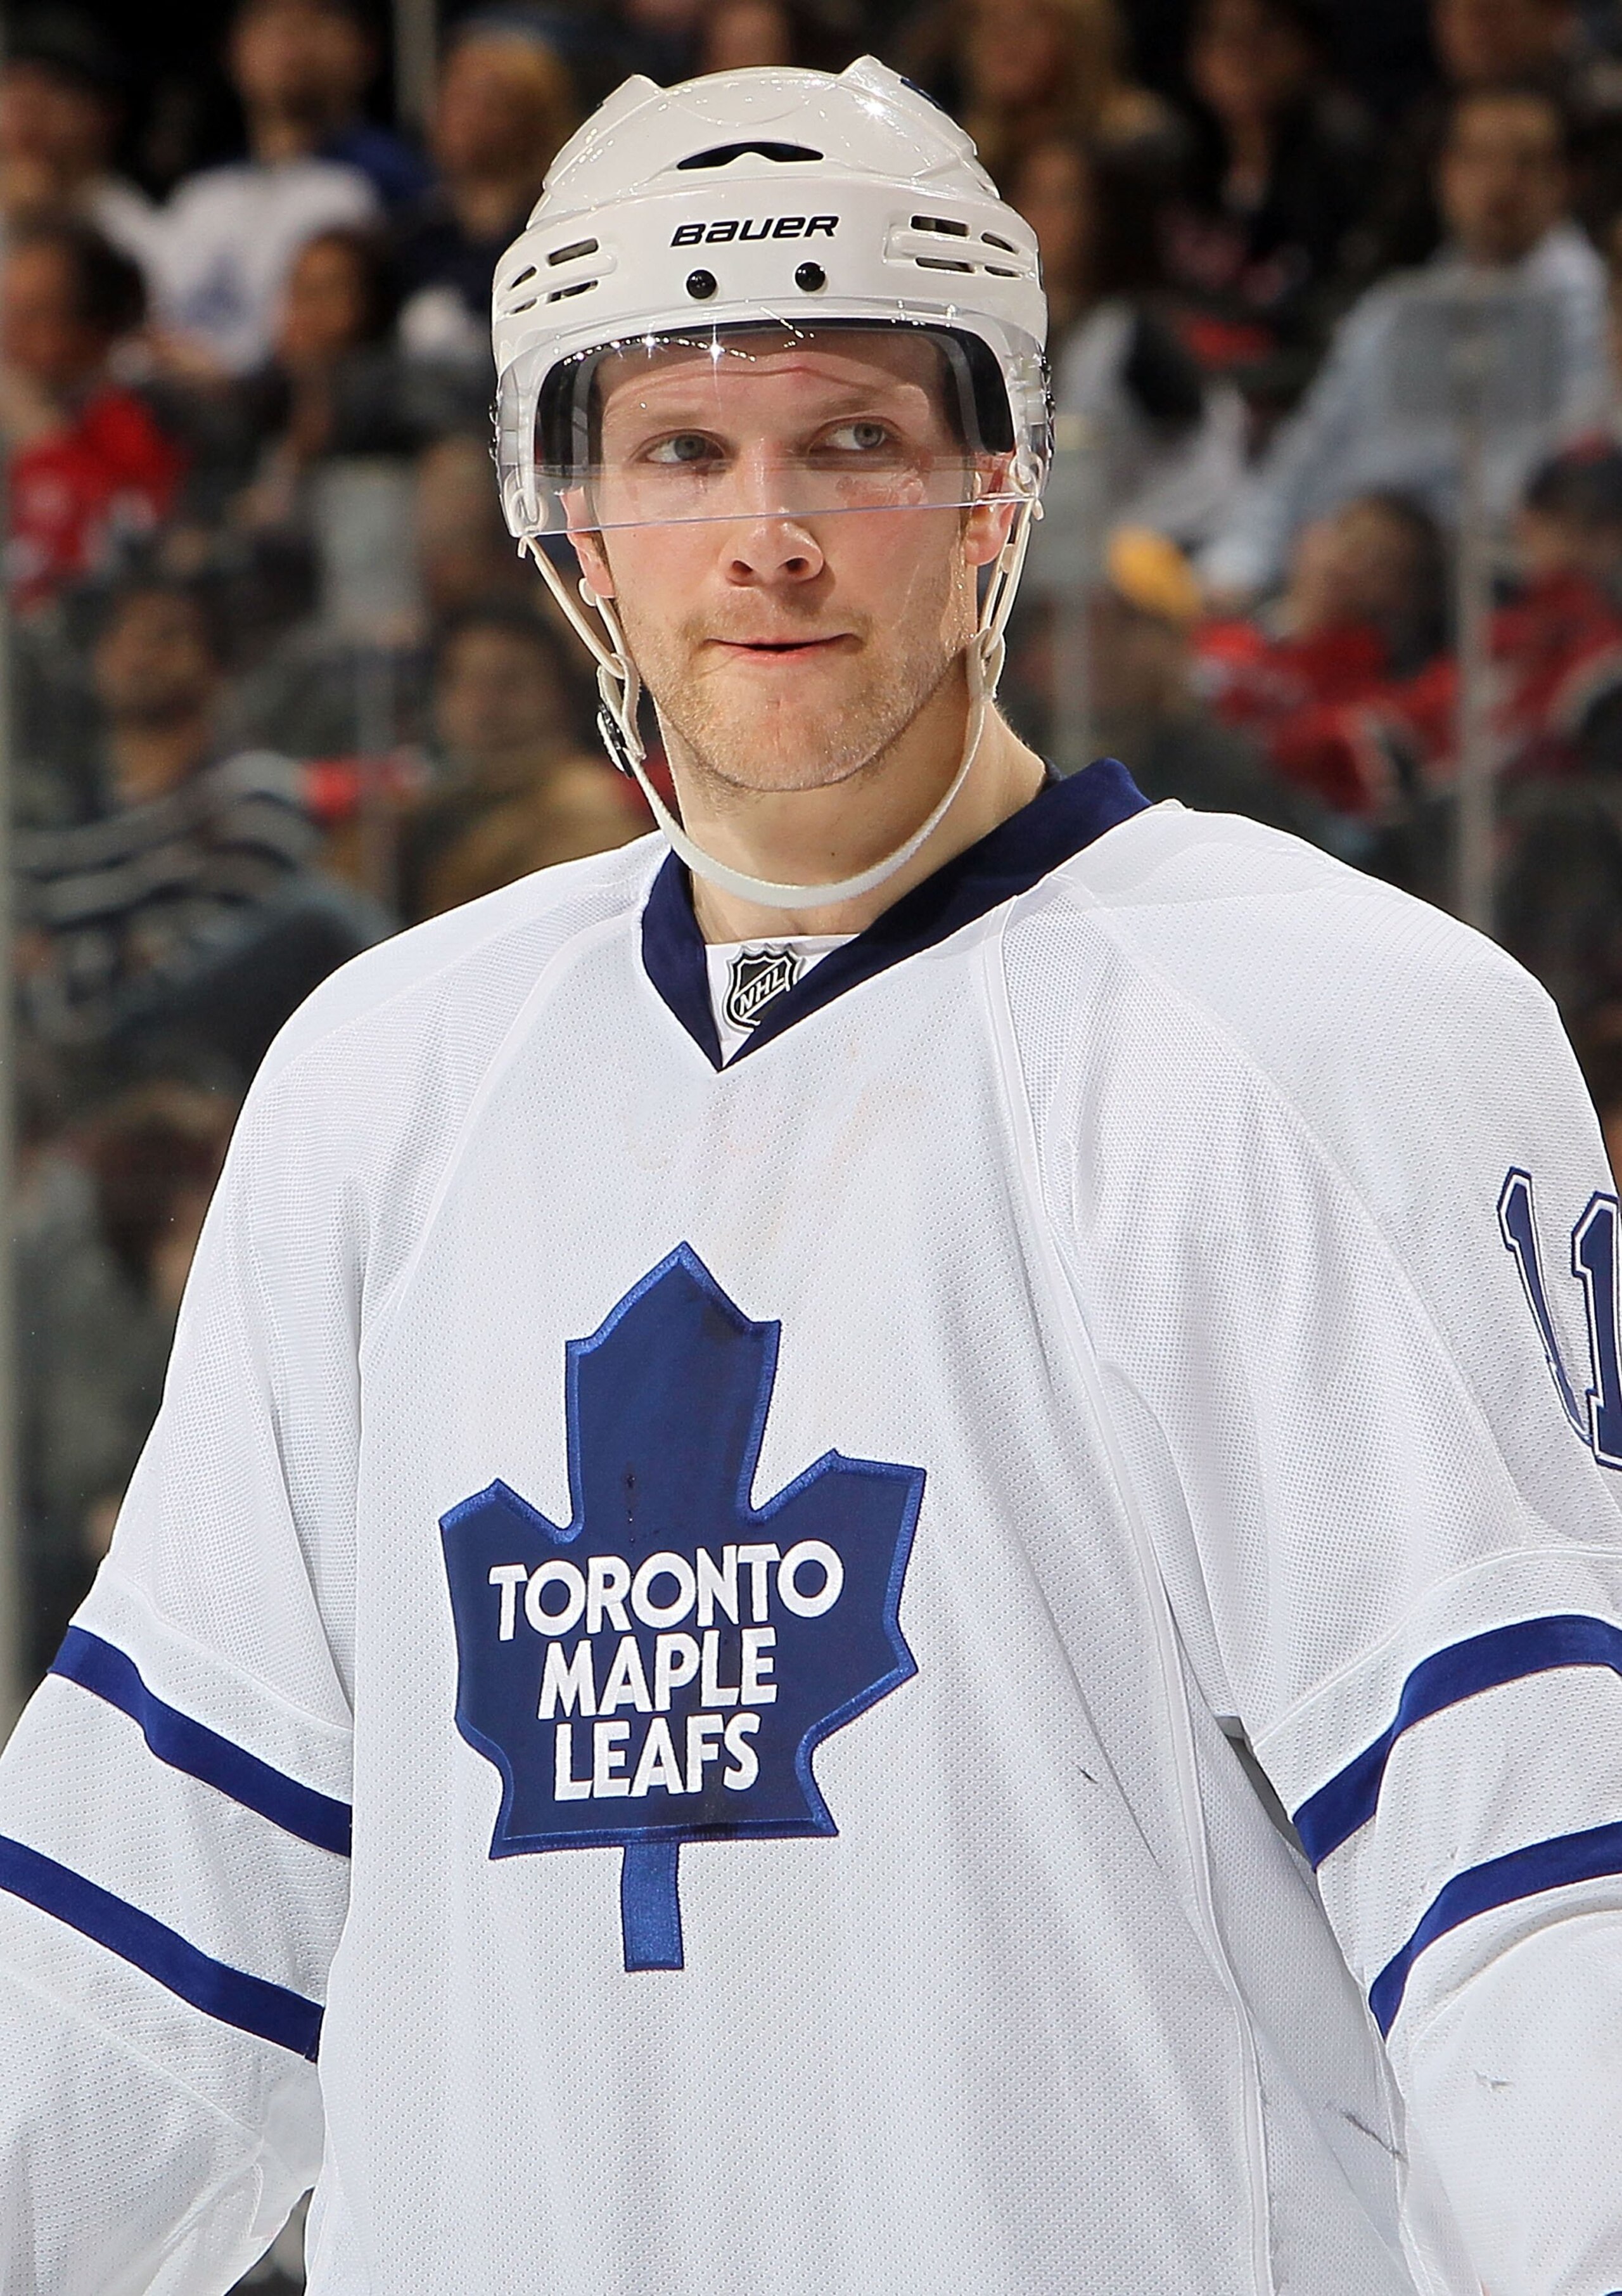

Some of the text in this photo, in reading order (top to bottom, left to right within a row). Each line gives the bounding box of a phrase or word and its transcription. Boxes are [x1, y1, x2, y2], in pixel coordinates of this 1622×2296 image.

[670, 215, 839, 247] BAUER
[738, 967, 785, 1016] NHL
[489, 1539, 844, 1641] TORONTO
[538, 1626, 777, 1719] MAPLE
[554, 1712, 760, 1801] LEAFS
